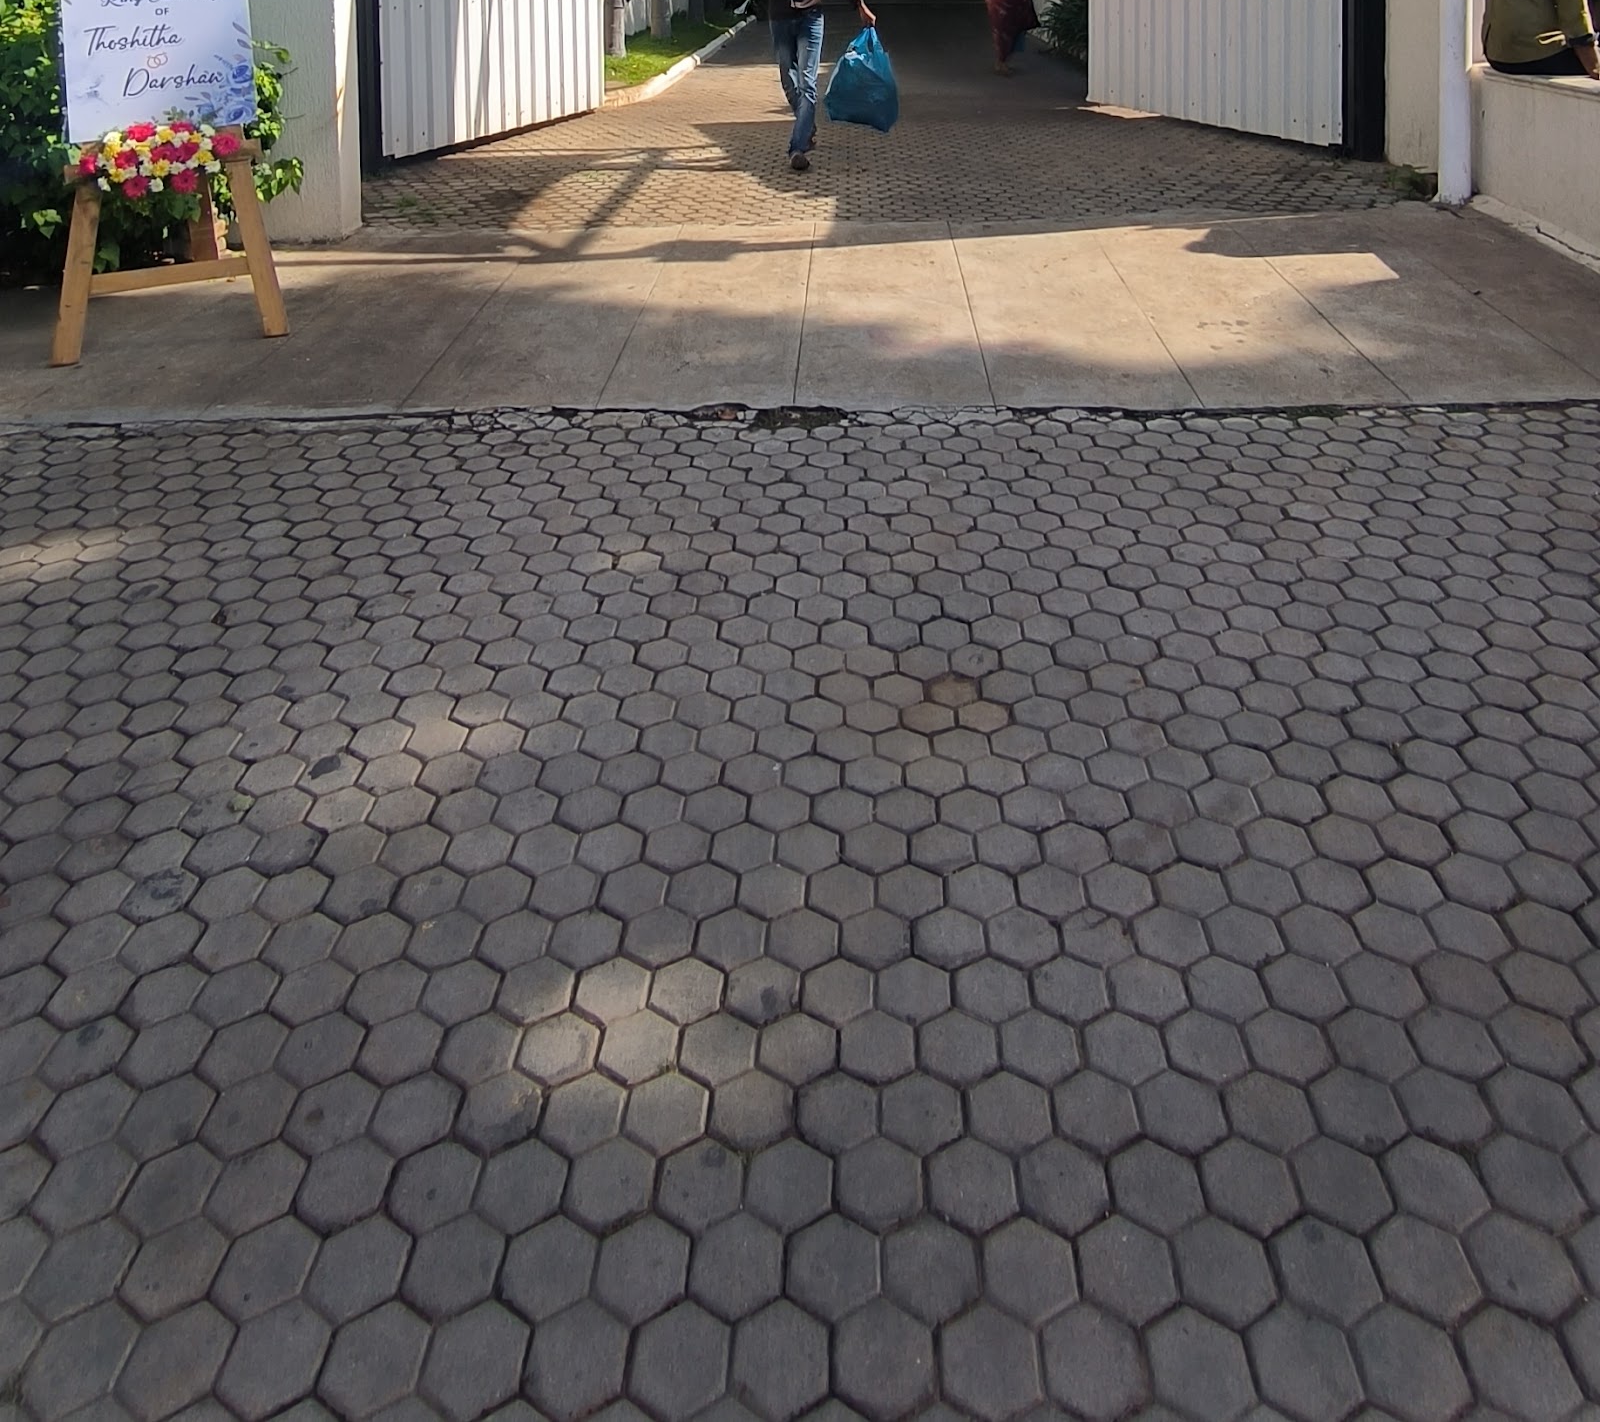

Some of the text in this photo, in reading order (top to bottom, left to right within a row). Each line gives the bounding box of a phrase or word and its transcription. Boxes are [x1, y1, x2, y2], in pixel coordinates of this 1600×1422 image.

[154, 7, 170, 16] OF
[83, 23, 183, 57] Thoshitha
[122, 63, 224, 98] Darshan
